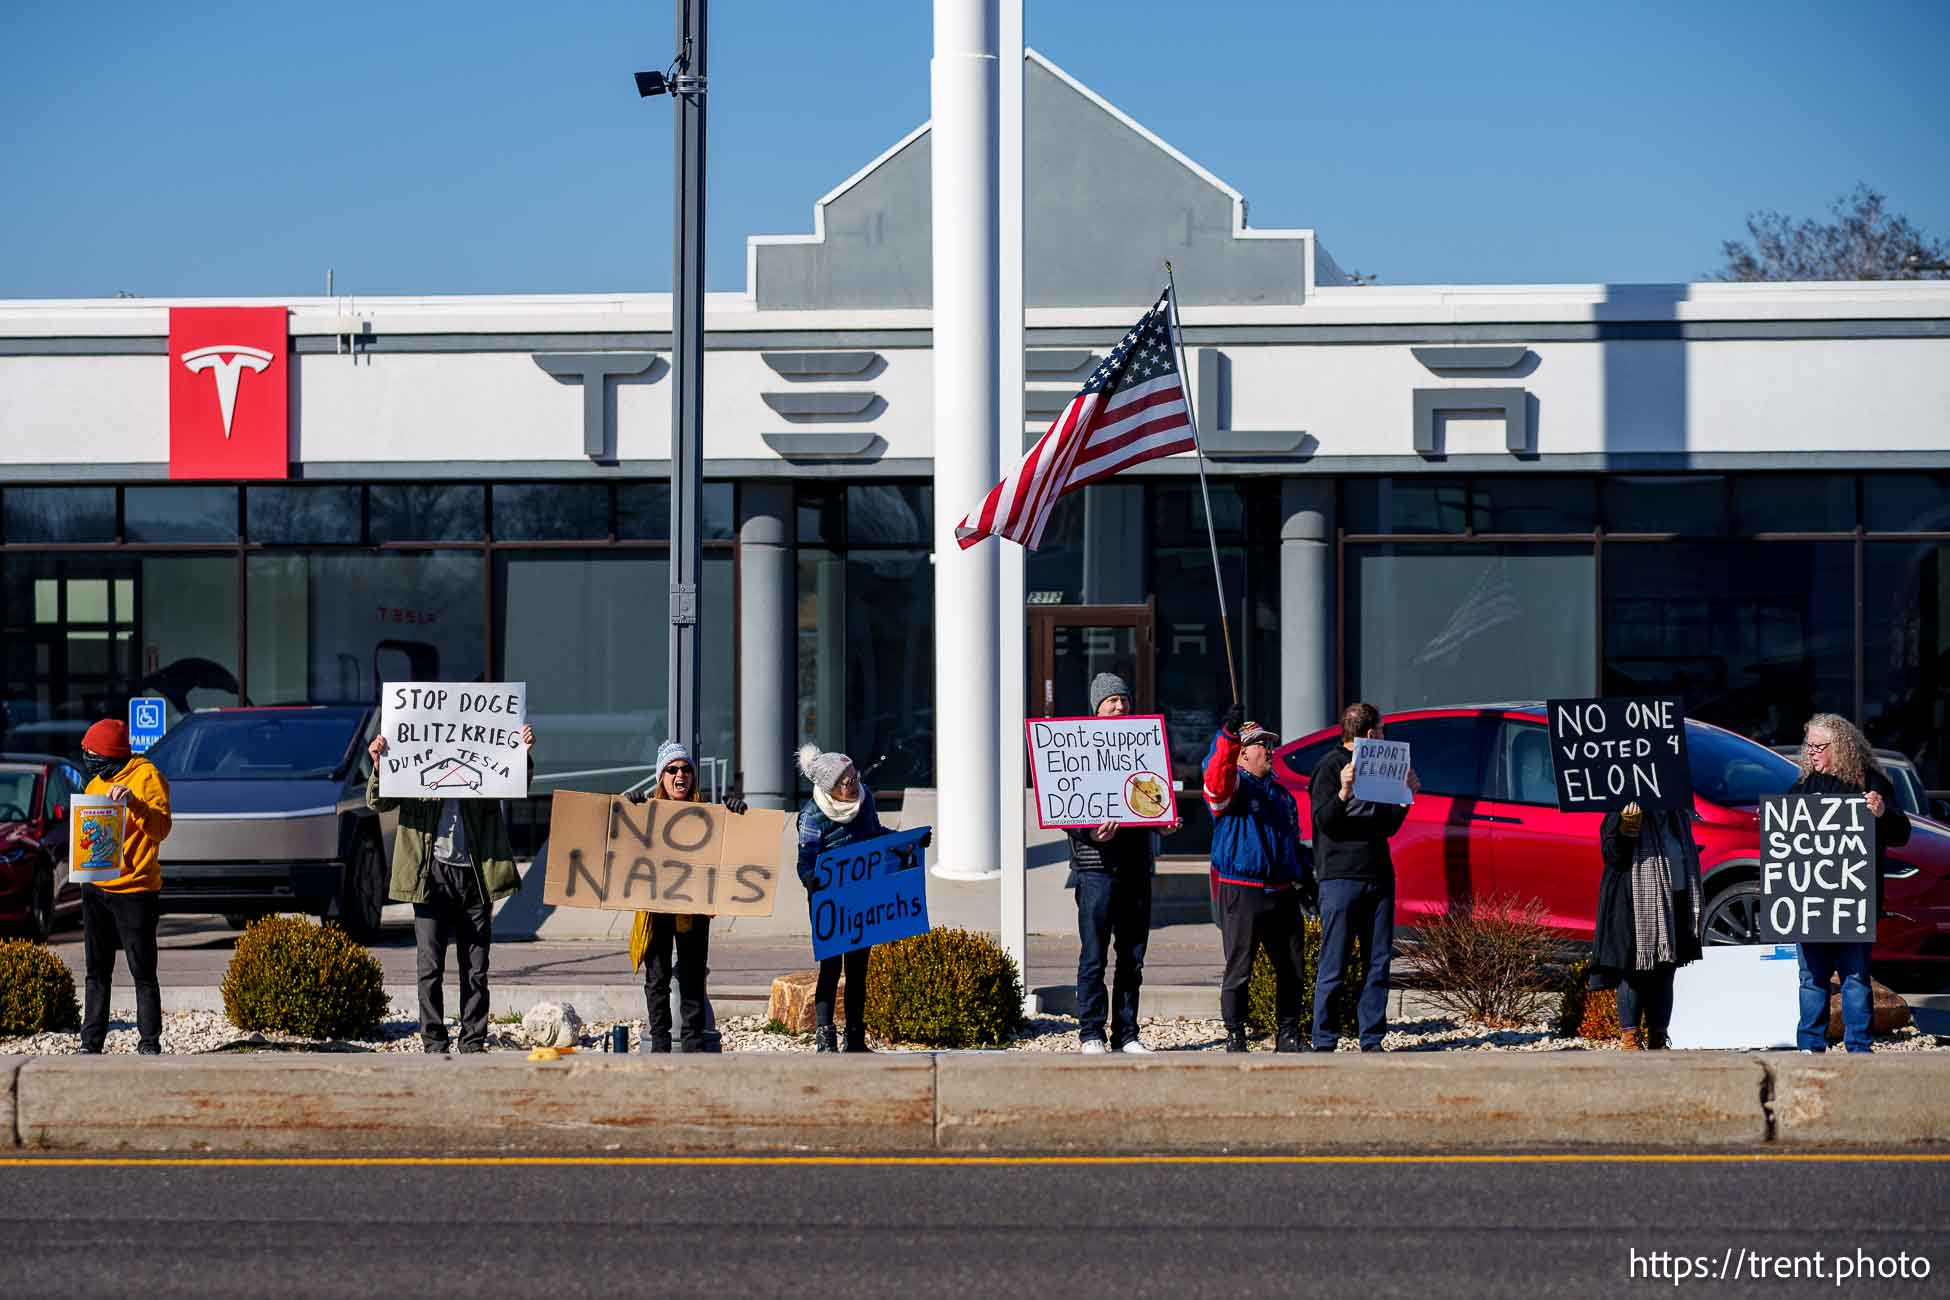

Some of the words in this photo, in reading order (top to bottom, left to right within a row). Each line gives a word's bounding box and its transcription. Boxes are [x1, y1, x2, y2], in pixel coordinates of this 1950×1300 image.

[395, 688, 447, 710] STOP
[460, 692, 519, 714] DOGE
[1558, 704, 1606, 737] NO
[1625, 701, 1674, 729] ONE
[397, 722, 521, 749] BLITZKRIEG
[1035, 724, 1089, 748] Dont
[1093, 725, 1160, 751] support
[1563, 738, 1651, 760] VOTED
[1667, 735, 1679, 755] 4
[388, 749, 433, 774] DUMP
[457, 748, 510, 778] TESLA
[1047, 750, 1090, 772] Elon
[1097, 749, 1148, 772] Musk
[1360, 745, 1408, 762] DEPORT
[1057, 776, 1082, 792] or
[1563, 762, 1661, 802] ELON
[609, 800, 714, 852] NO
[1764, 798, 1868, 832] NAZI
[1769, 832, 1867, 859] SCUM
[565, 848, 772, 905] NAZIS
[816, 851, 881, 891] STOP
[1764, 858, 1868, 895] FUCK
[815, 893, 922, 945] Oligarchs
[1770, 896, 1867, 935] OFF!
